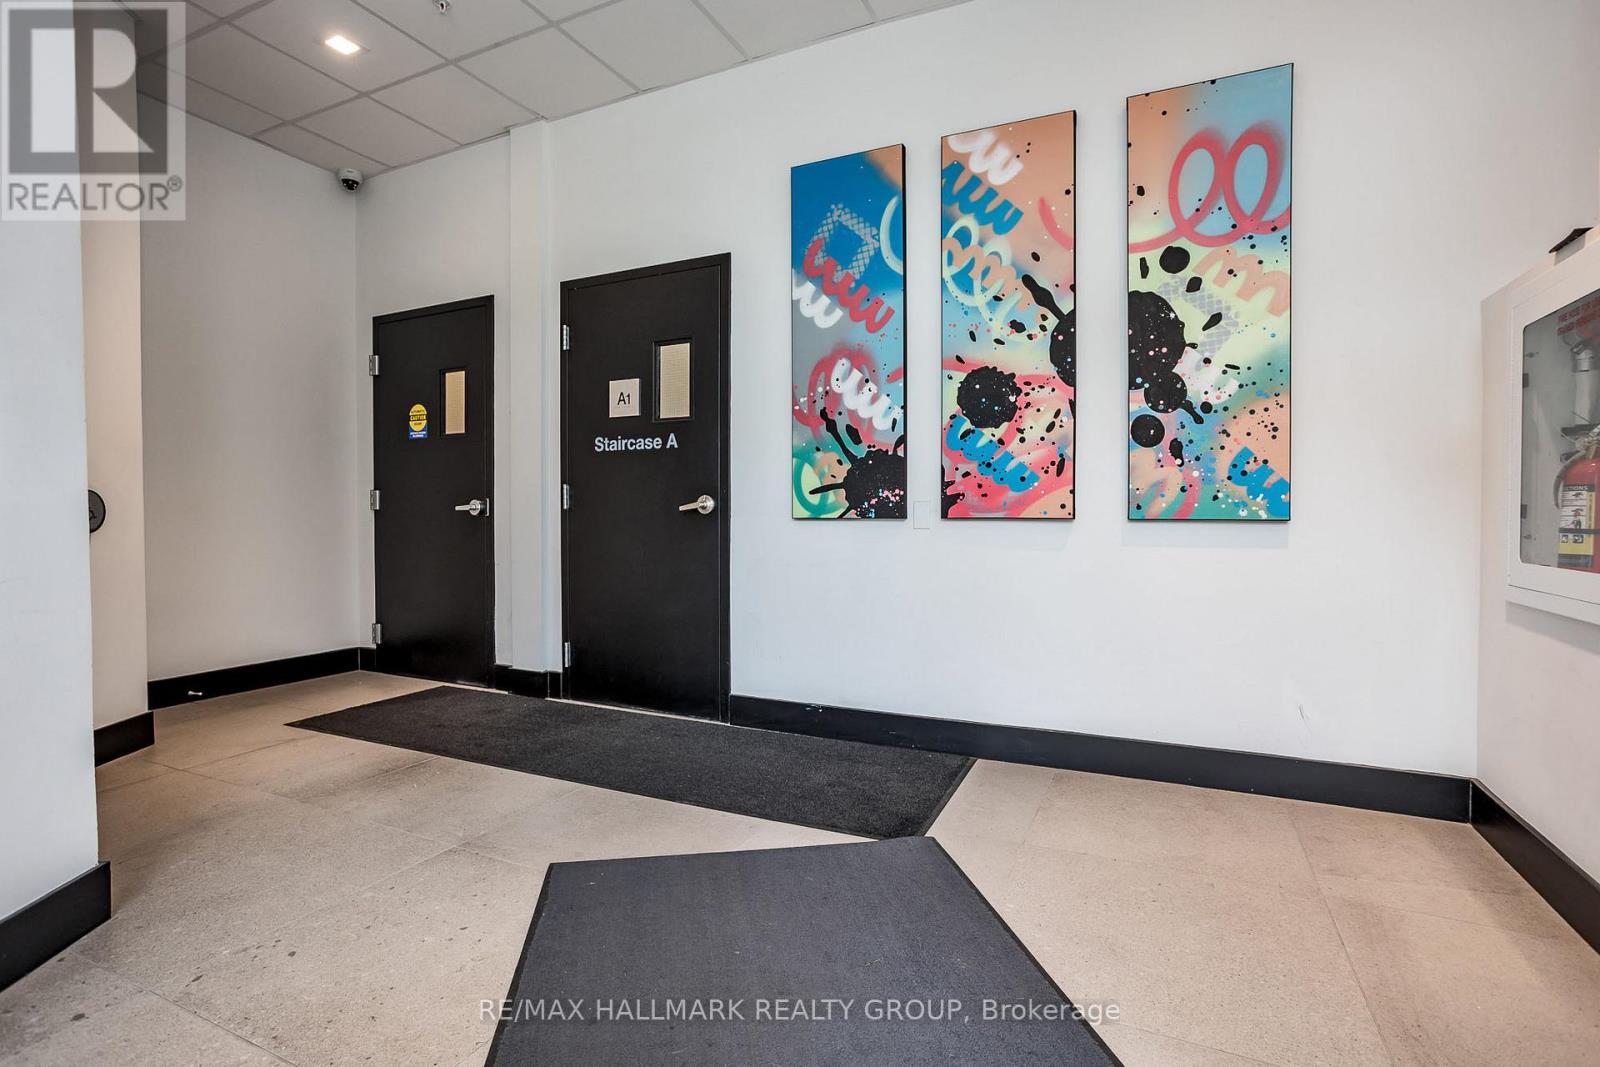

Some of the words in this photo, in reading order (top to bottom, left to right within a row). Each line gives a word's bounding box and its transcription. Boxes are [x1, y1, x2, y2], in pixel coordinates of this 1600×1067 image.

[617, 392, 631, 405] A1
[594, 436, 662, 452] Staircase
[666, 433, 679, 449] A
